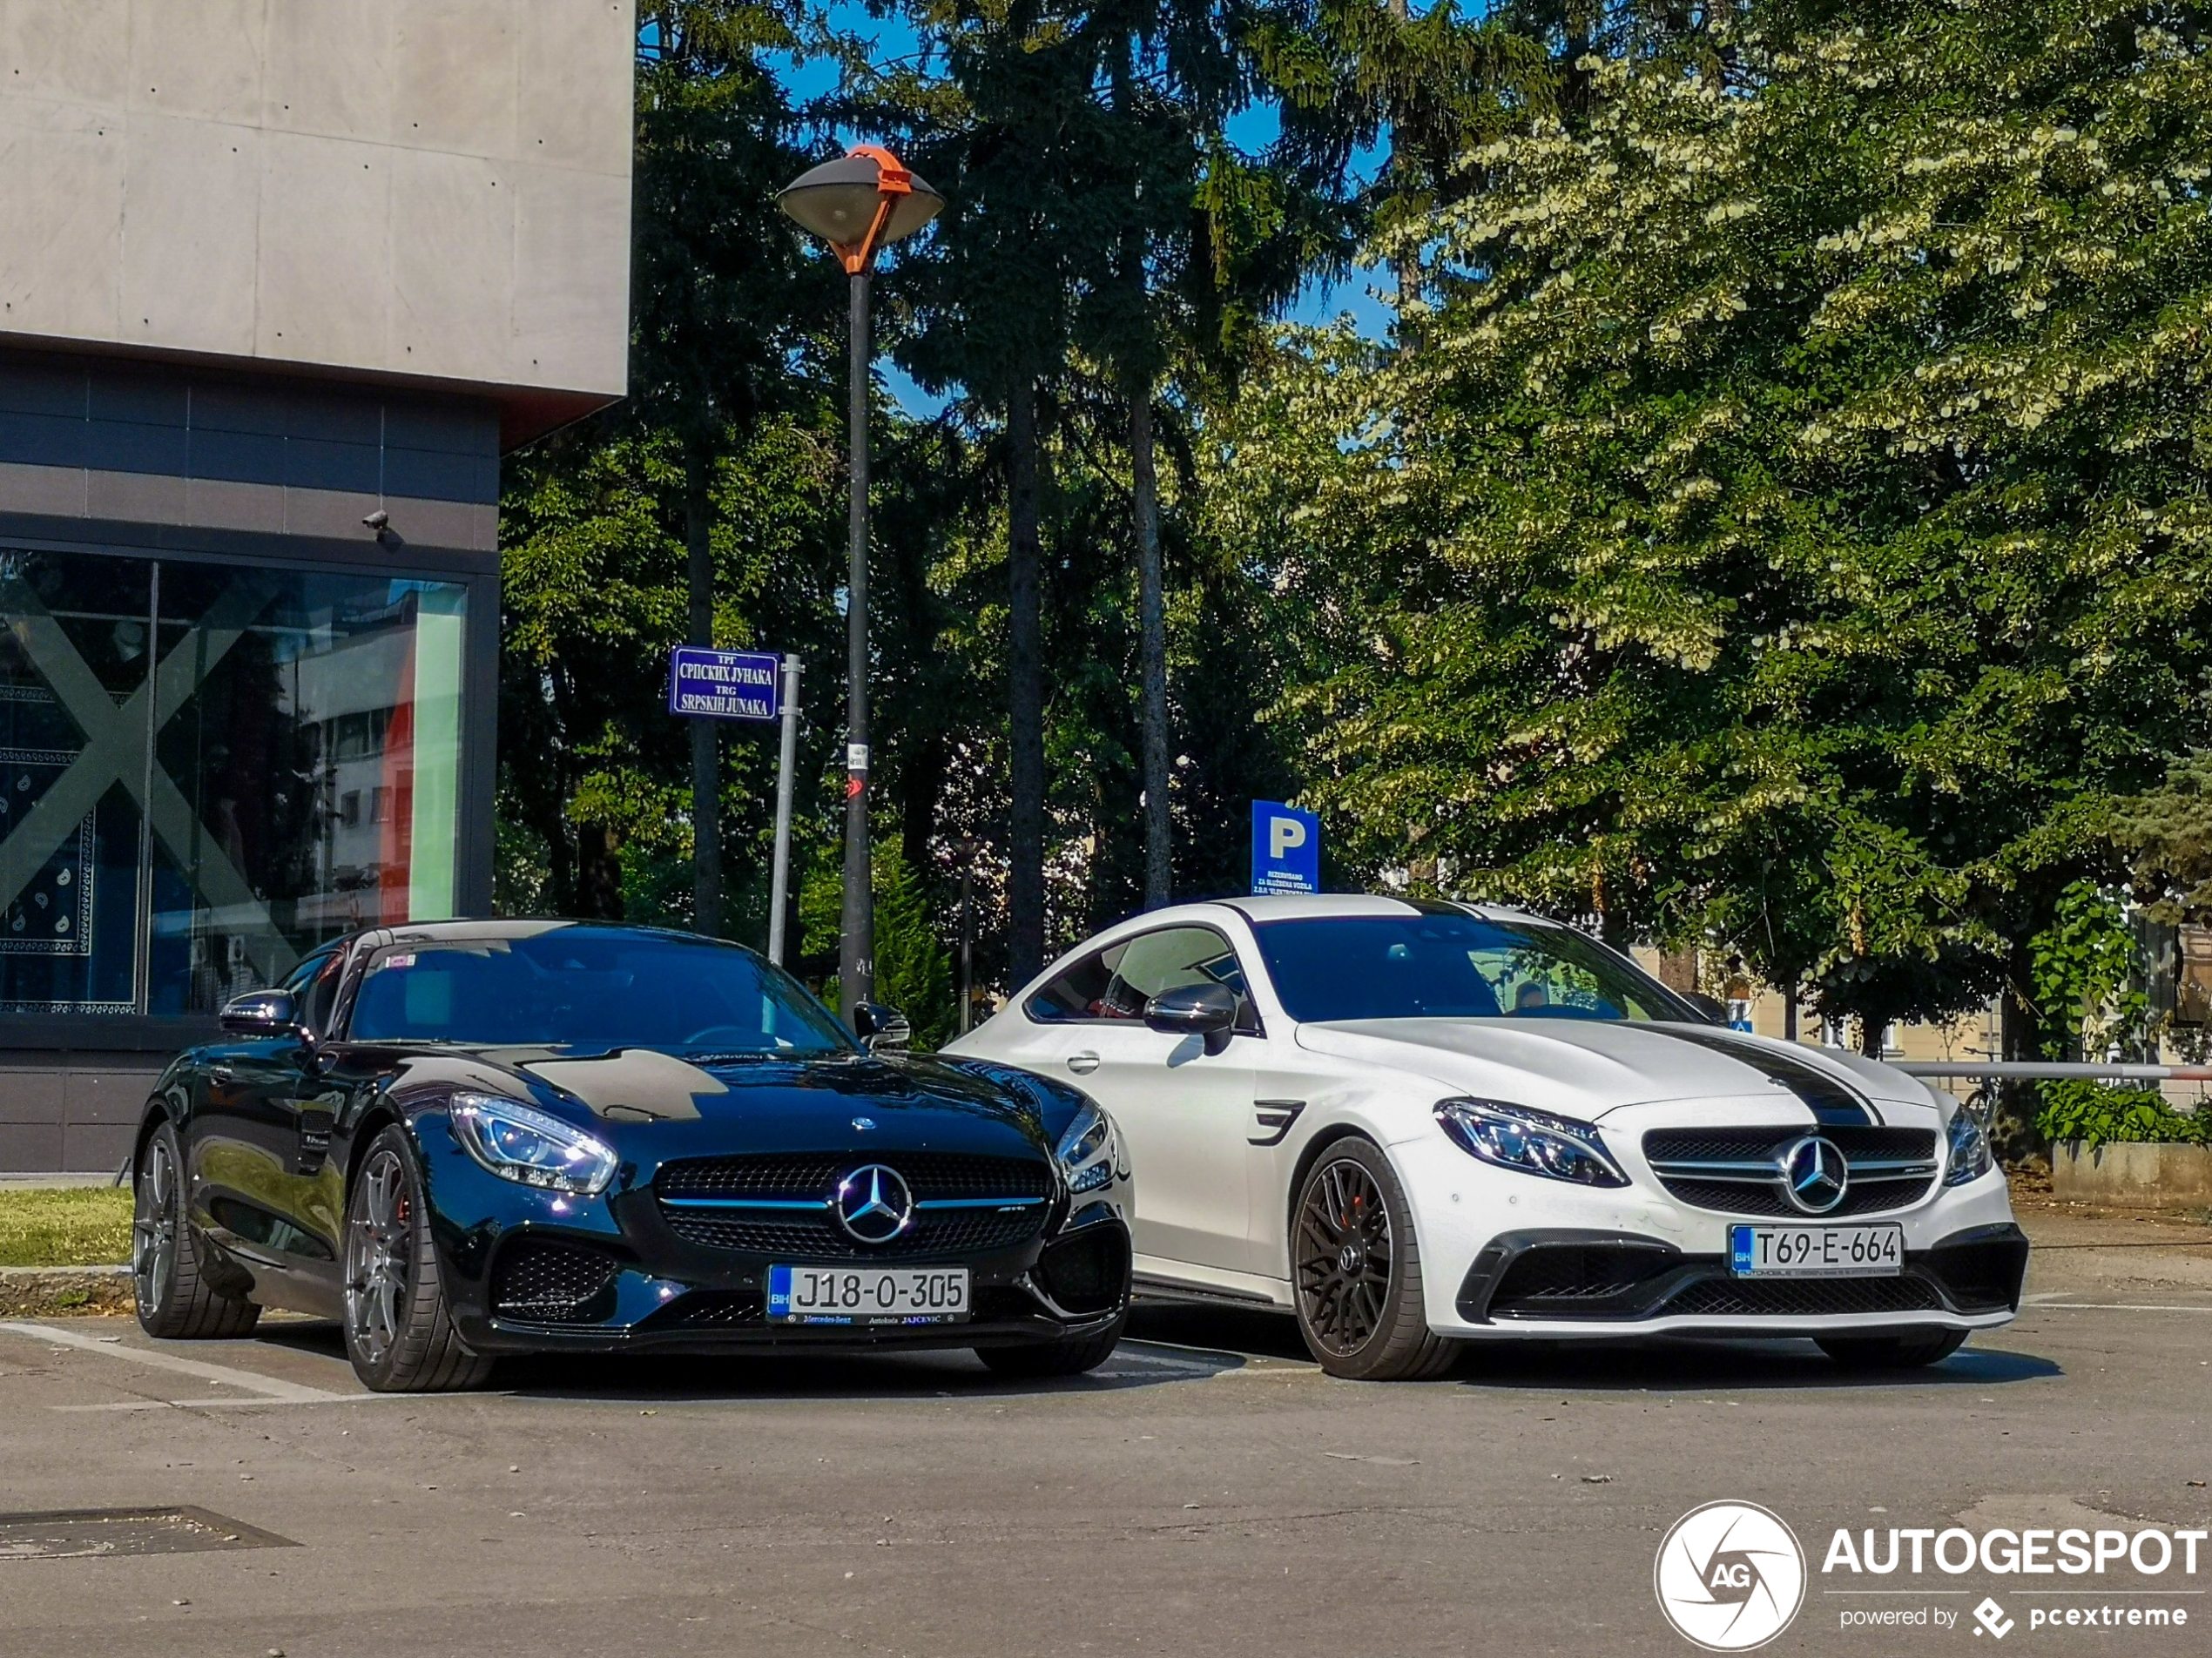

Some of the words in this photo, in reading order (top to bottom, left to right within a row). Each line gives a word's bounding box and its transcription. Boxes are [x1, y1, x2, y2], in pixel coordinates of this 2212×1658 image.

[718, 655, 737, 665] ТРГ
[679, 663, 730, 682] СРПСКИХ
[731, 667, 772, 685] ЈУНАКА
[715, 685, 737, 695] TRG
[681, 693, 725, 712] SRPSKIH
[726, 698, 767, 715] JUNAKA
[1270, 816, 1306, 859] P
[1757, 1231, 1896, 1264] T69-E-664
[771, 1294, 790, 1304] BIH
